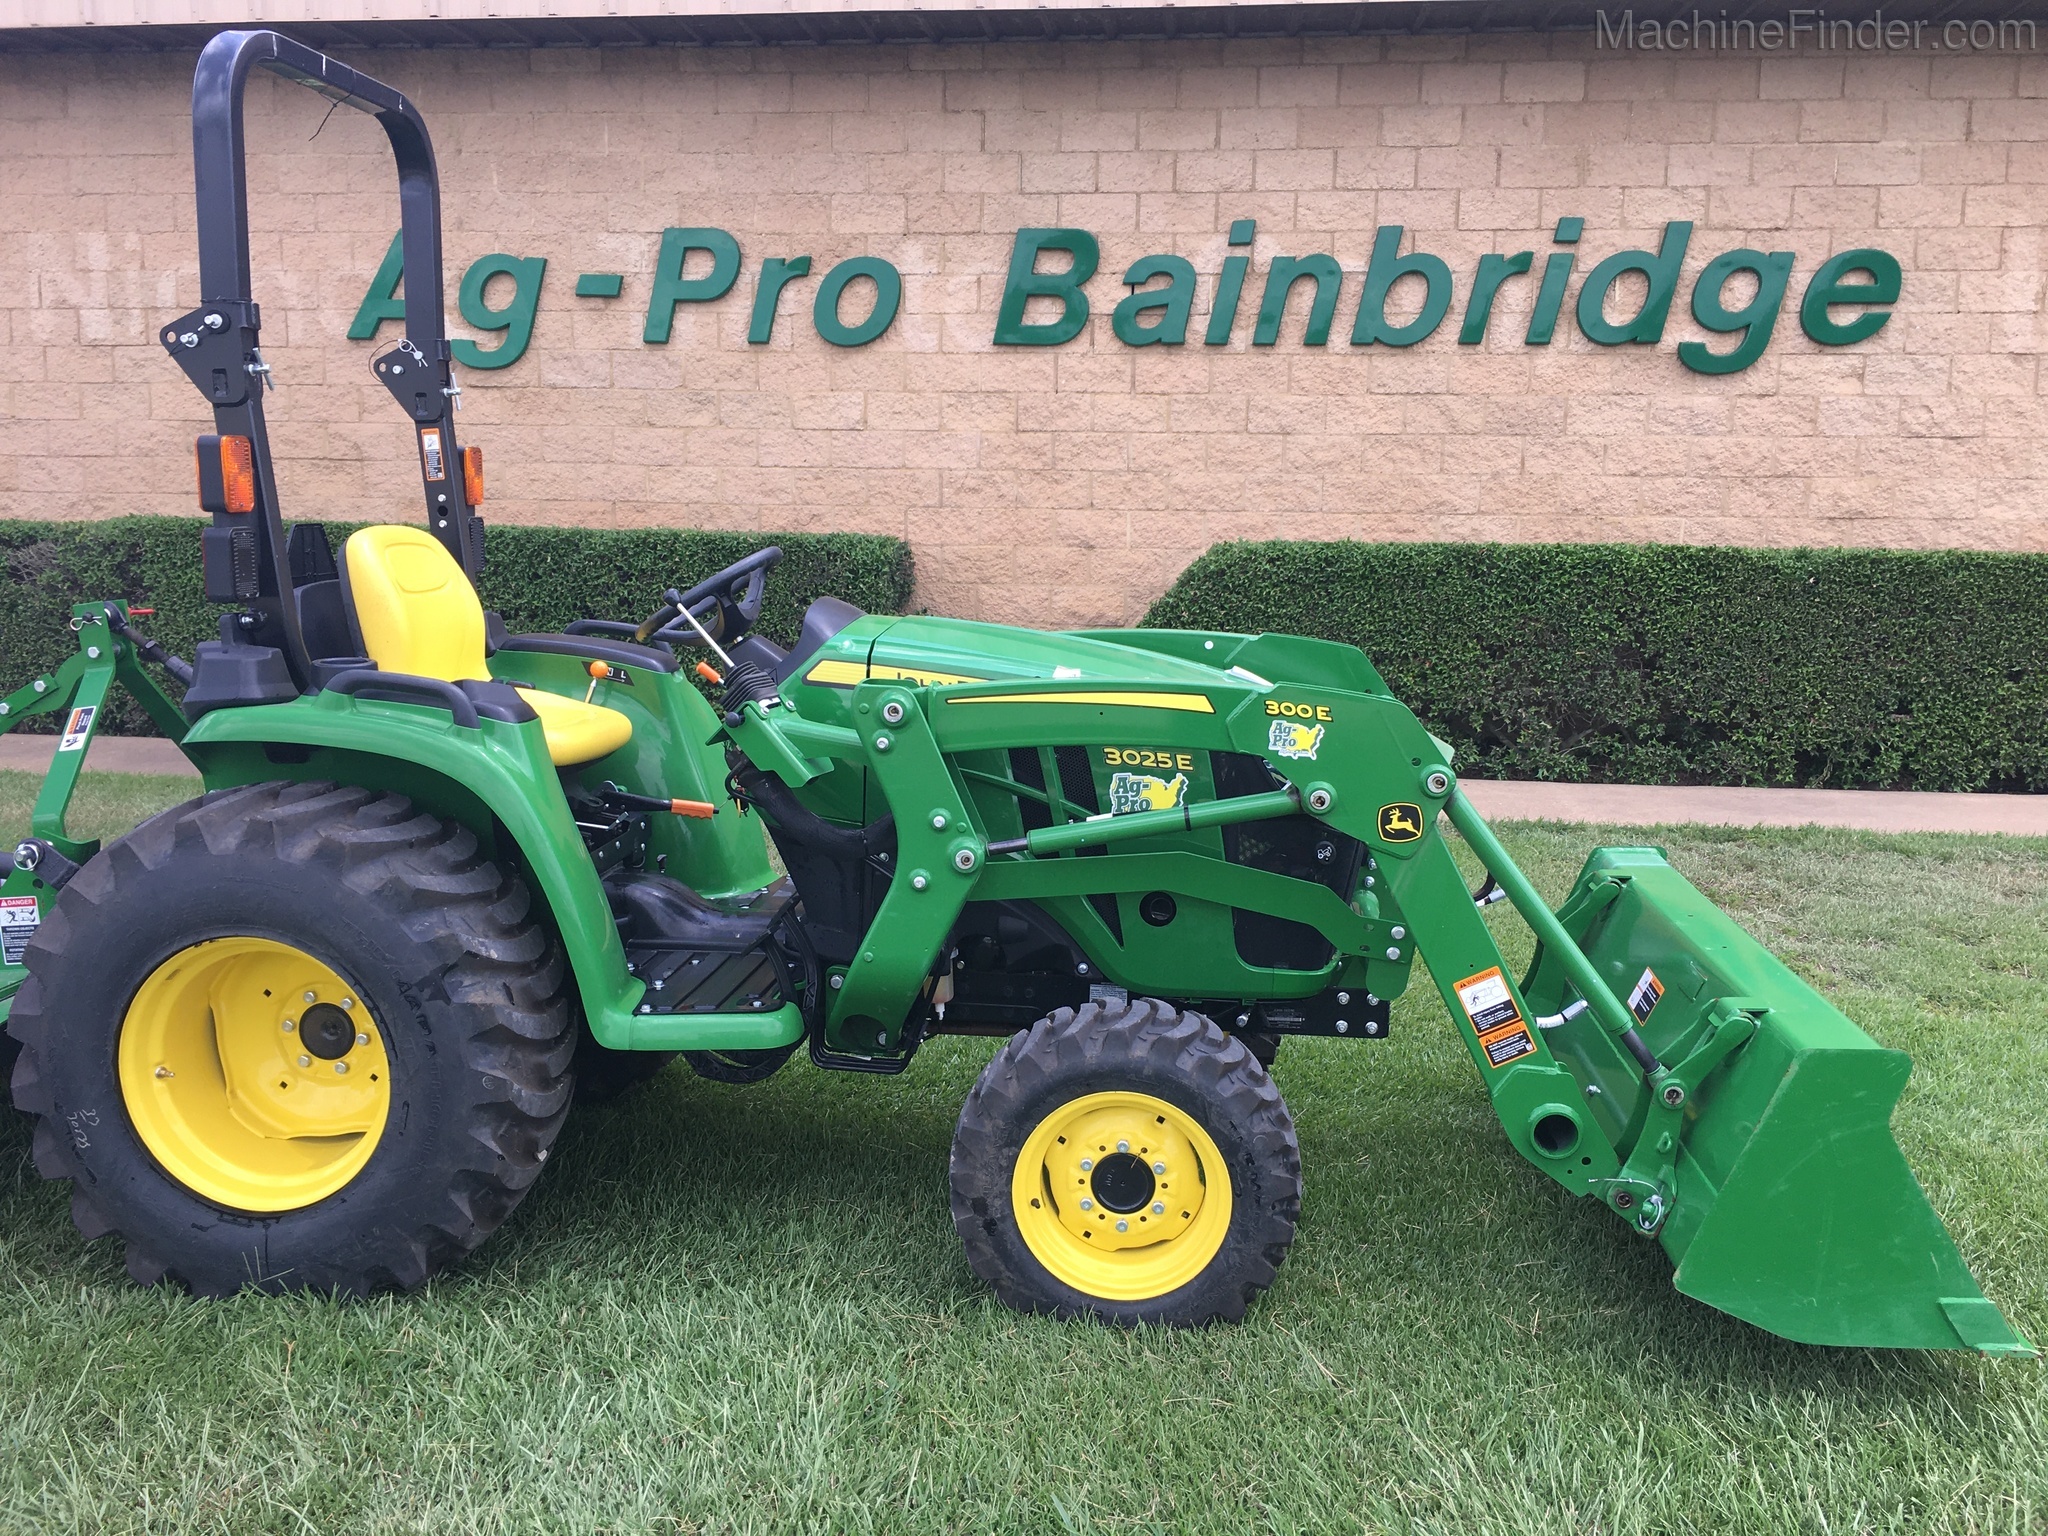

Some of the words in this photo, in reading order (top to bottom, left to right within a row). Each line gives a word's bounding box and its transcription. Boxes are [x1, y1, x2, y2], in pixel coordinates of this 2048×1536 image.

[993, 217, 1904, 375] Bainbridge
[1271, 735, 1297, 747] Pro
[1114, 795, 1152, 813] Pro
[1466, 970, 1495, 985] WARNING
[1492, 1025, 1522, 1040] WARNING
